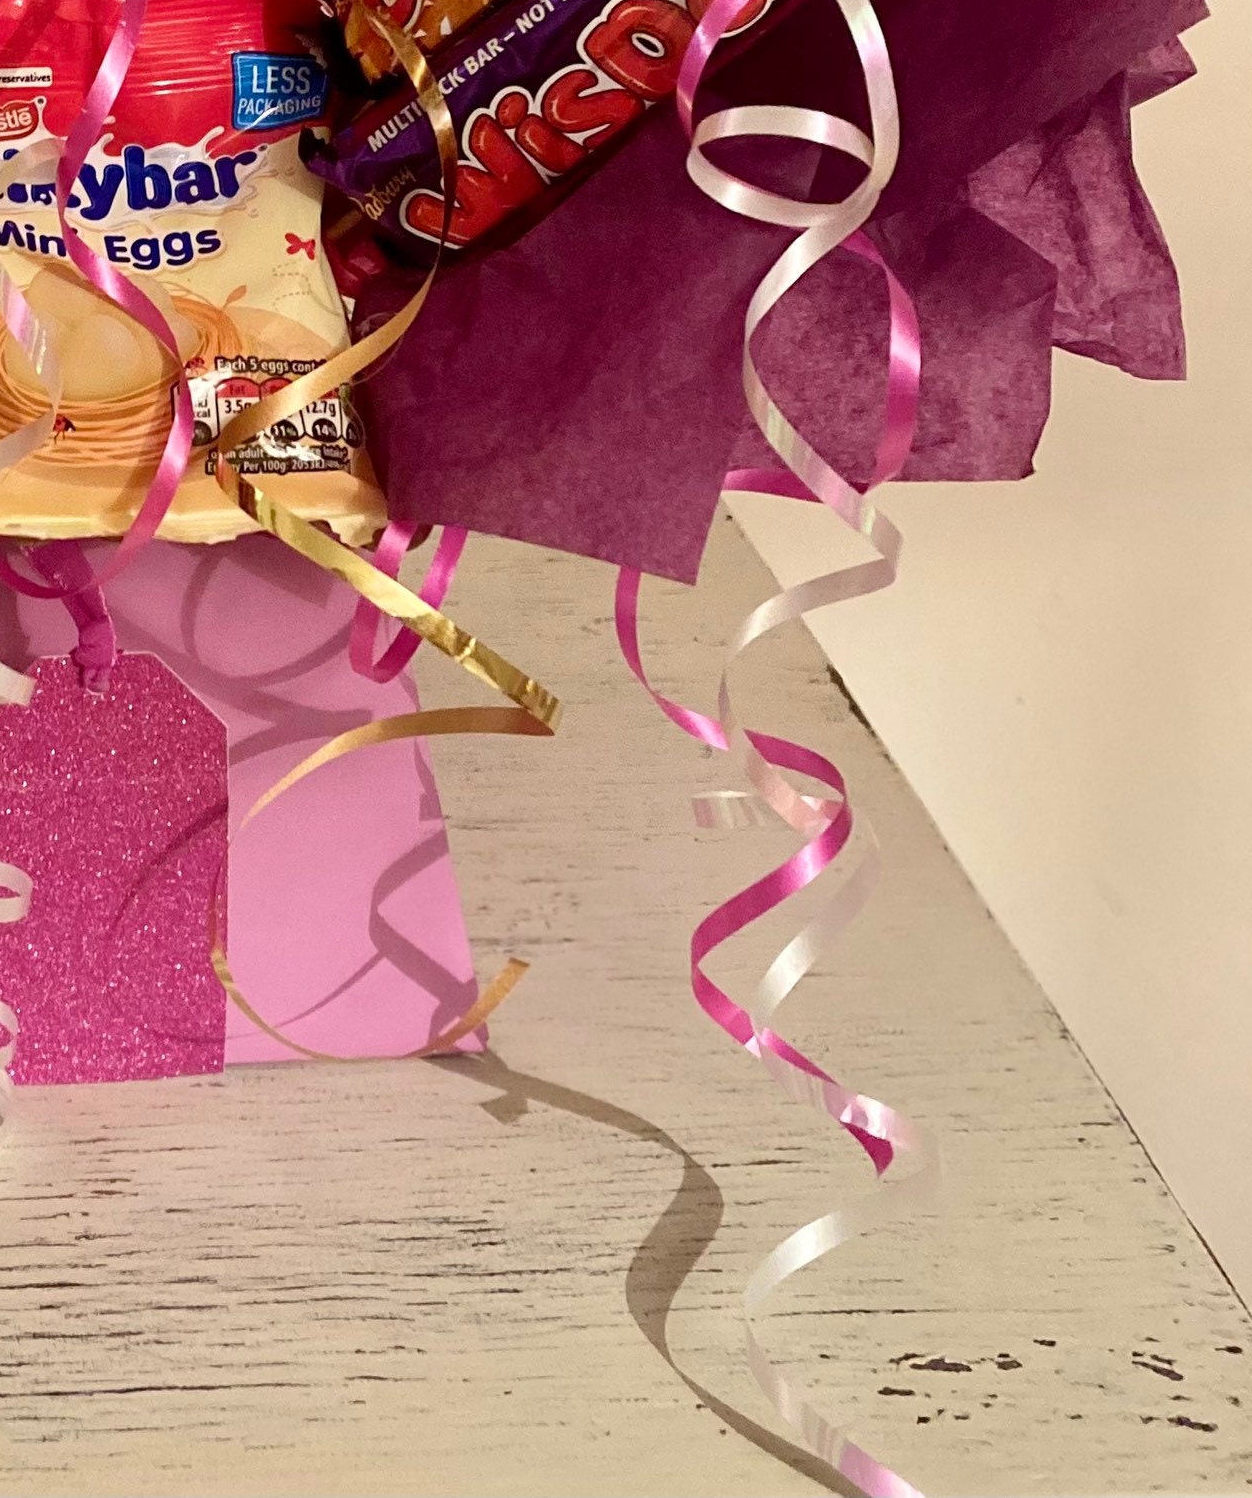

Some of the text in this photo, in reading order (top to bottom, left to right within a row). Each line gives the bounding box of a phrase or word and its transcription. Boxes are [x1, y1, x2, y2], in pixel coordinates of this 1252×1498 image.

[251, 64, 311, 95] LESS
[237, 94, 321, 116] PACKAGING
[366, 70, 466, 152] MULTICK
[462, 37, 504, 77] BAR
[104, 229, 222, 270] Eggs
[217, 357, 246, 371] Each
[250, 358, 258, 371] 5
[261, 361, 289, 374] eggs
[243, 460, 259, 471] Per
